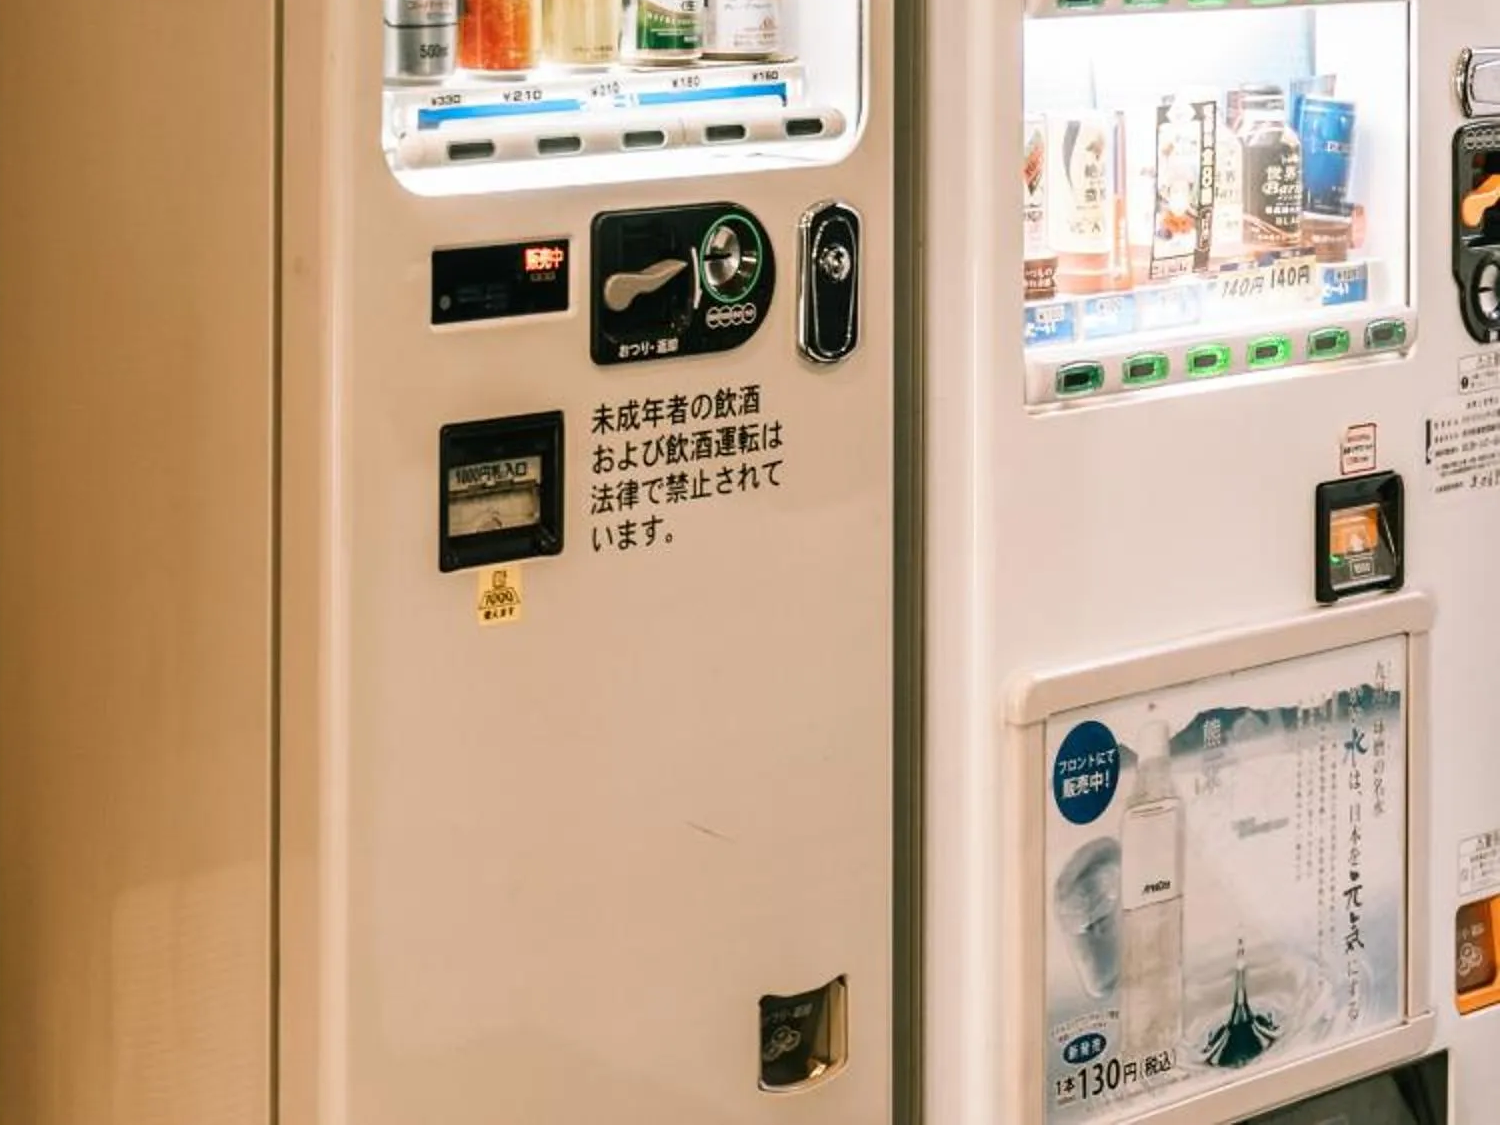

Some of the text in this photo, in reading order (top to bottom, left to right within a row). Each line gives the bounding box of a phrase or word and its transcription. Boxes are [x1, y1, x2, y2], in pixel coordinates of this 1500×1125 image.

[503, 90, 542, 102] ¥210
[1222, 276, 1265, 298] 140円
[1270, 264, 1311, 289] 140円
[592, 385, 761, 435] 未成年者の飲酒
[592, 421, 783, 473] および飲酒運転は
[591, 460, 784, 515] 法律で禁止されて
[592, 515, 675, 553] います。
[1058, 748, 1117, 774] フロントにて
[1063, 769, 1110, 797] 販売中!
